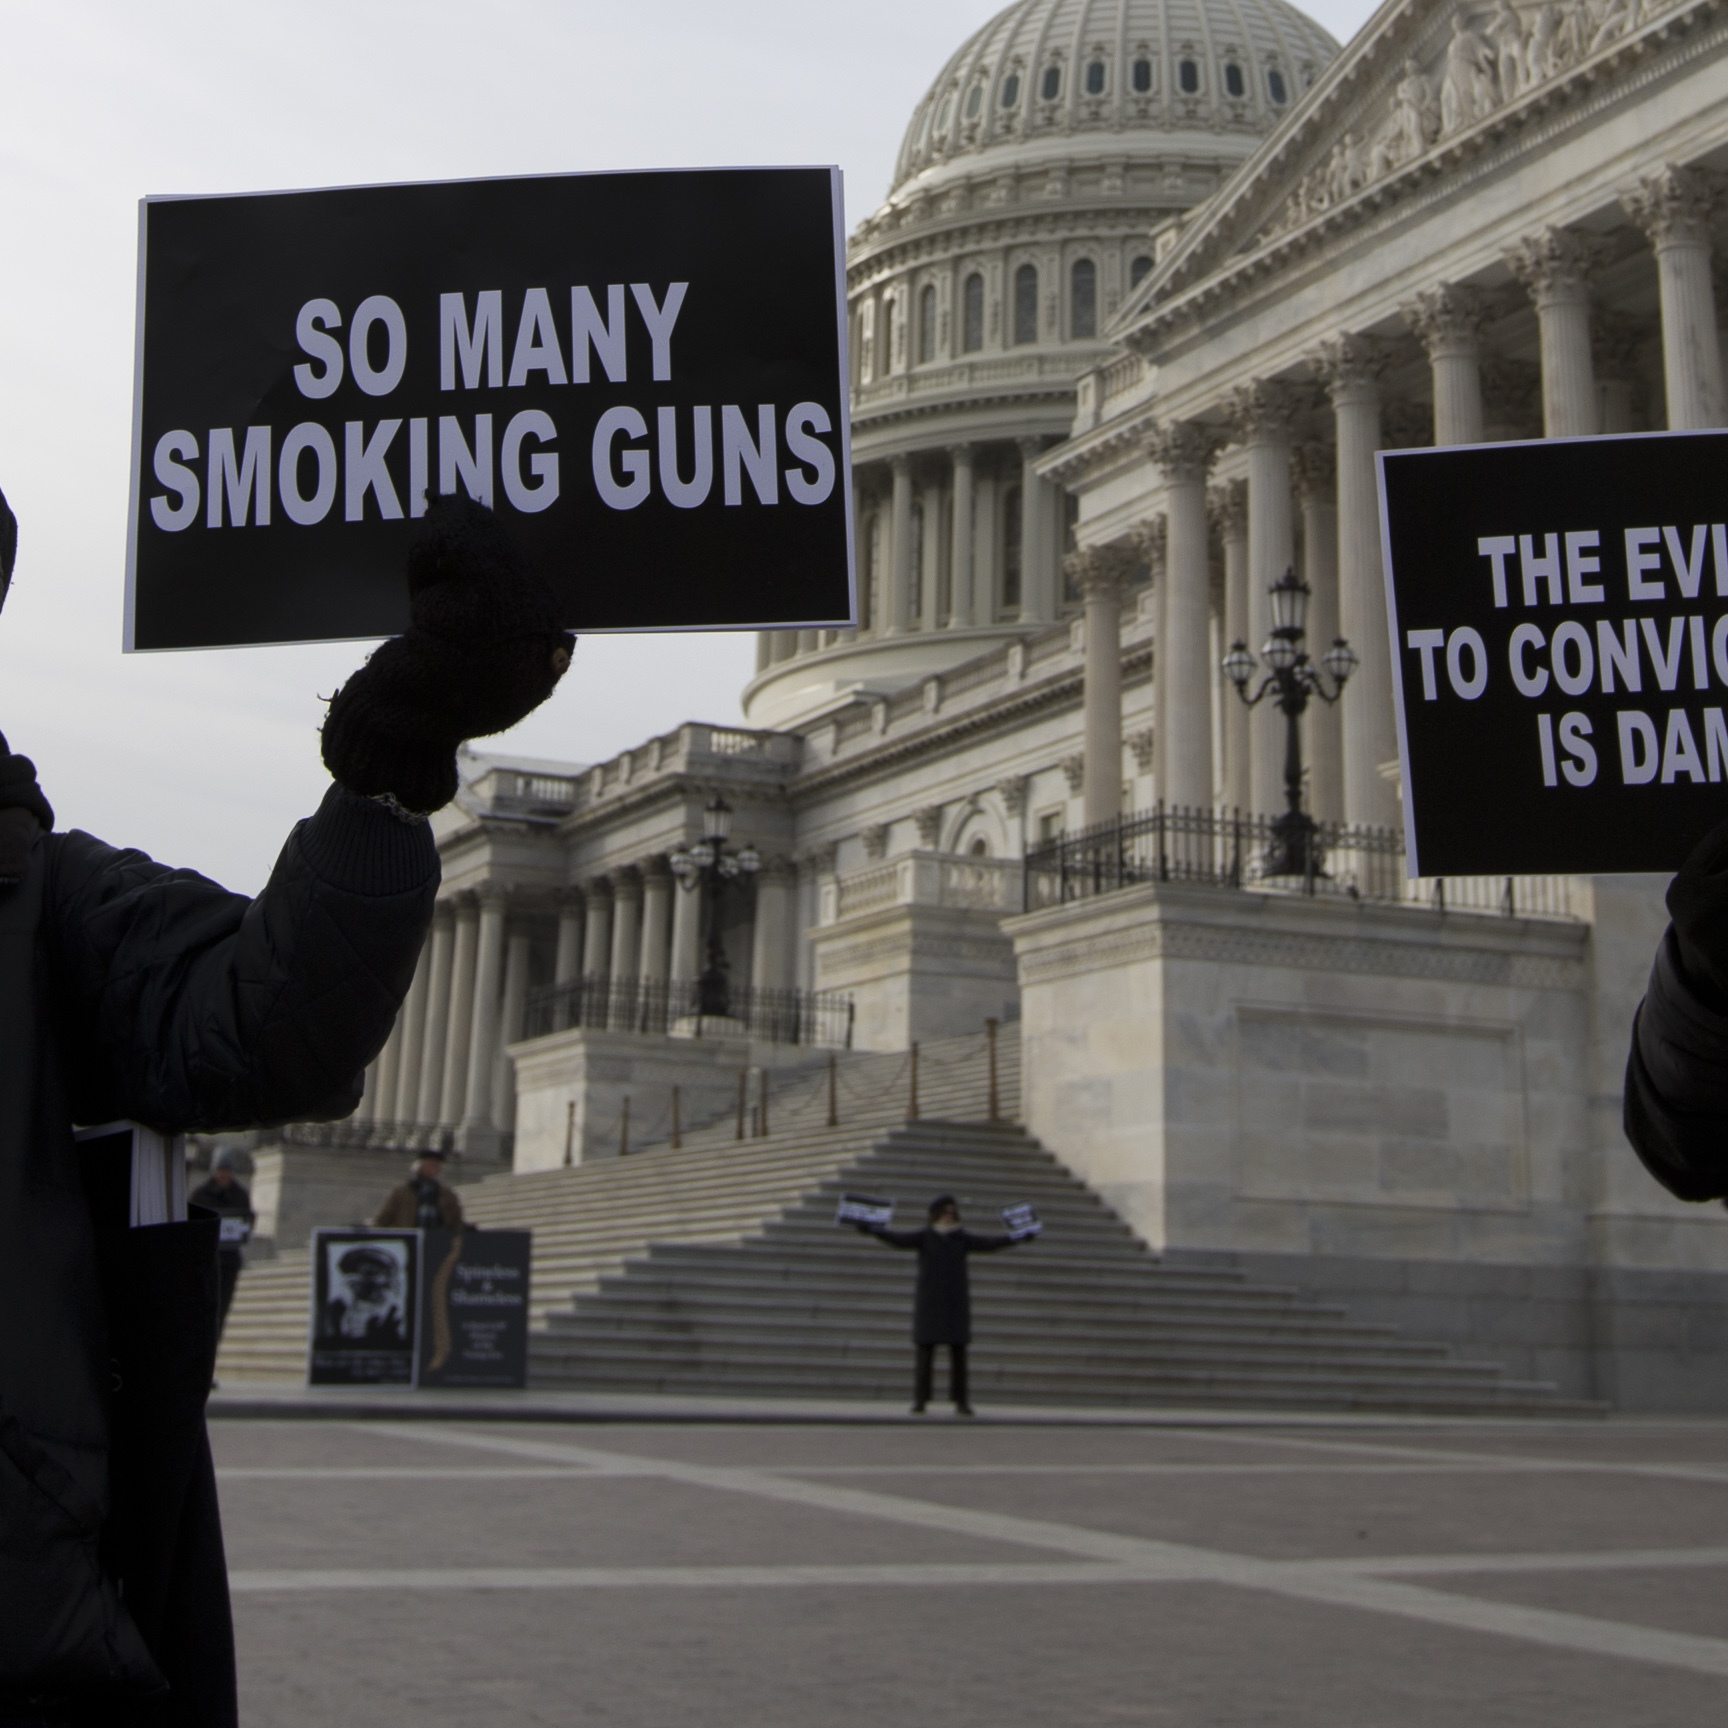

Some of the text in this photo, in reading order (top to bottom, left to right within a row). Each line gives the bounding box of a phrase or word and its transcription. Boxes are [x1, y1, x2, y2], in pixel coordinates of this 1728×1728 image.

[293, 282, 689, 399] SO MANY
[150, 401, 835, 532] SMOKING GUNS
[1478, 529, 1605, 608] THE
[1407, 626, 1488, 701] TO
[1538, 711, 1598, 787] IS
